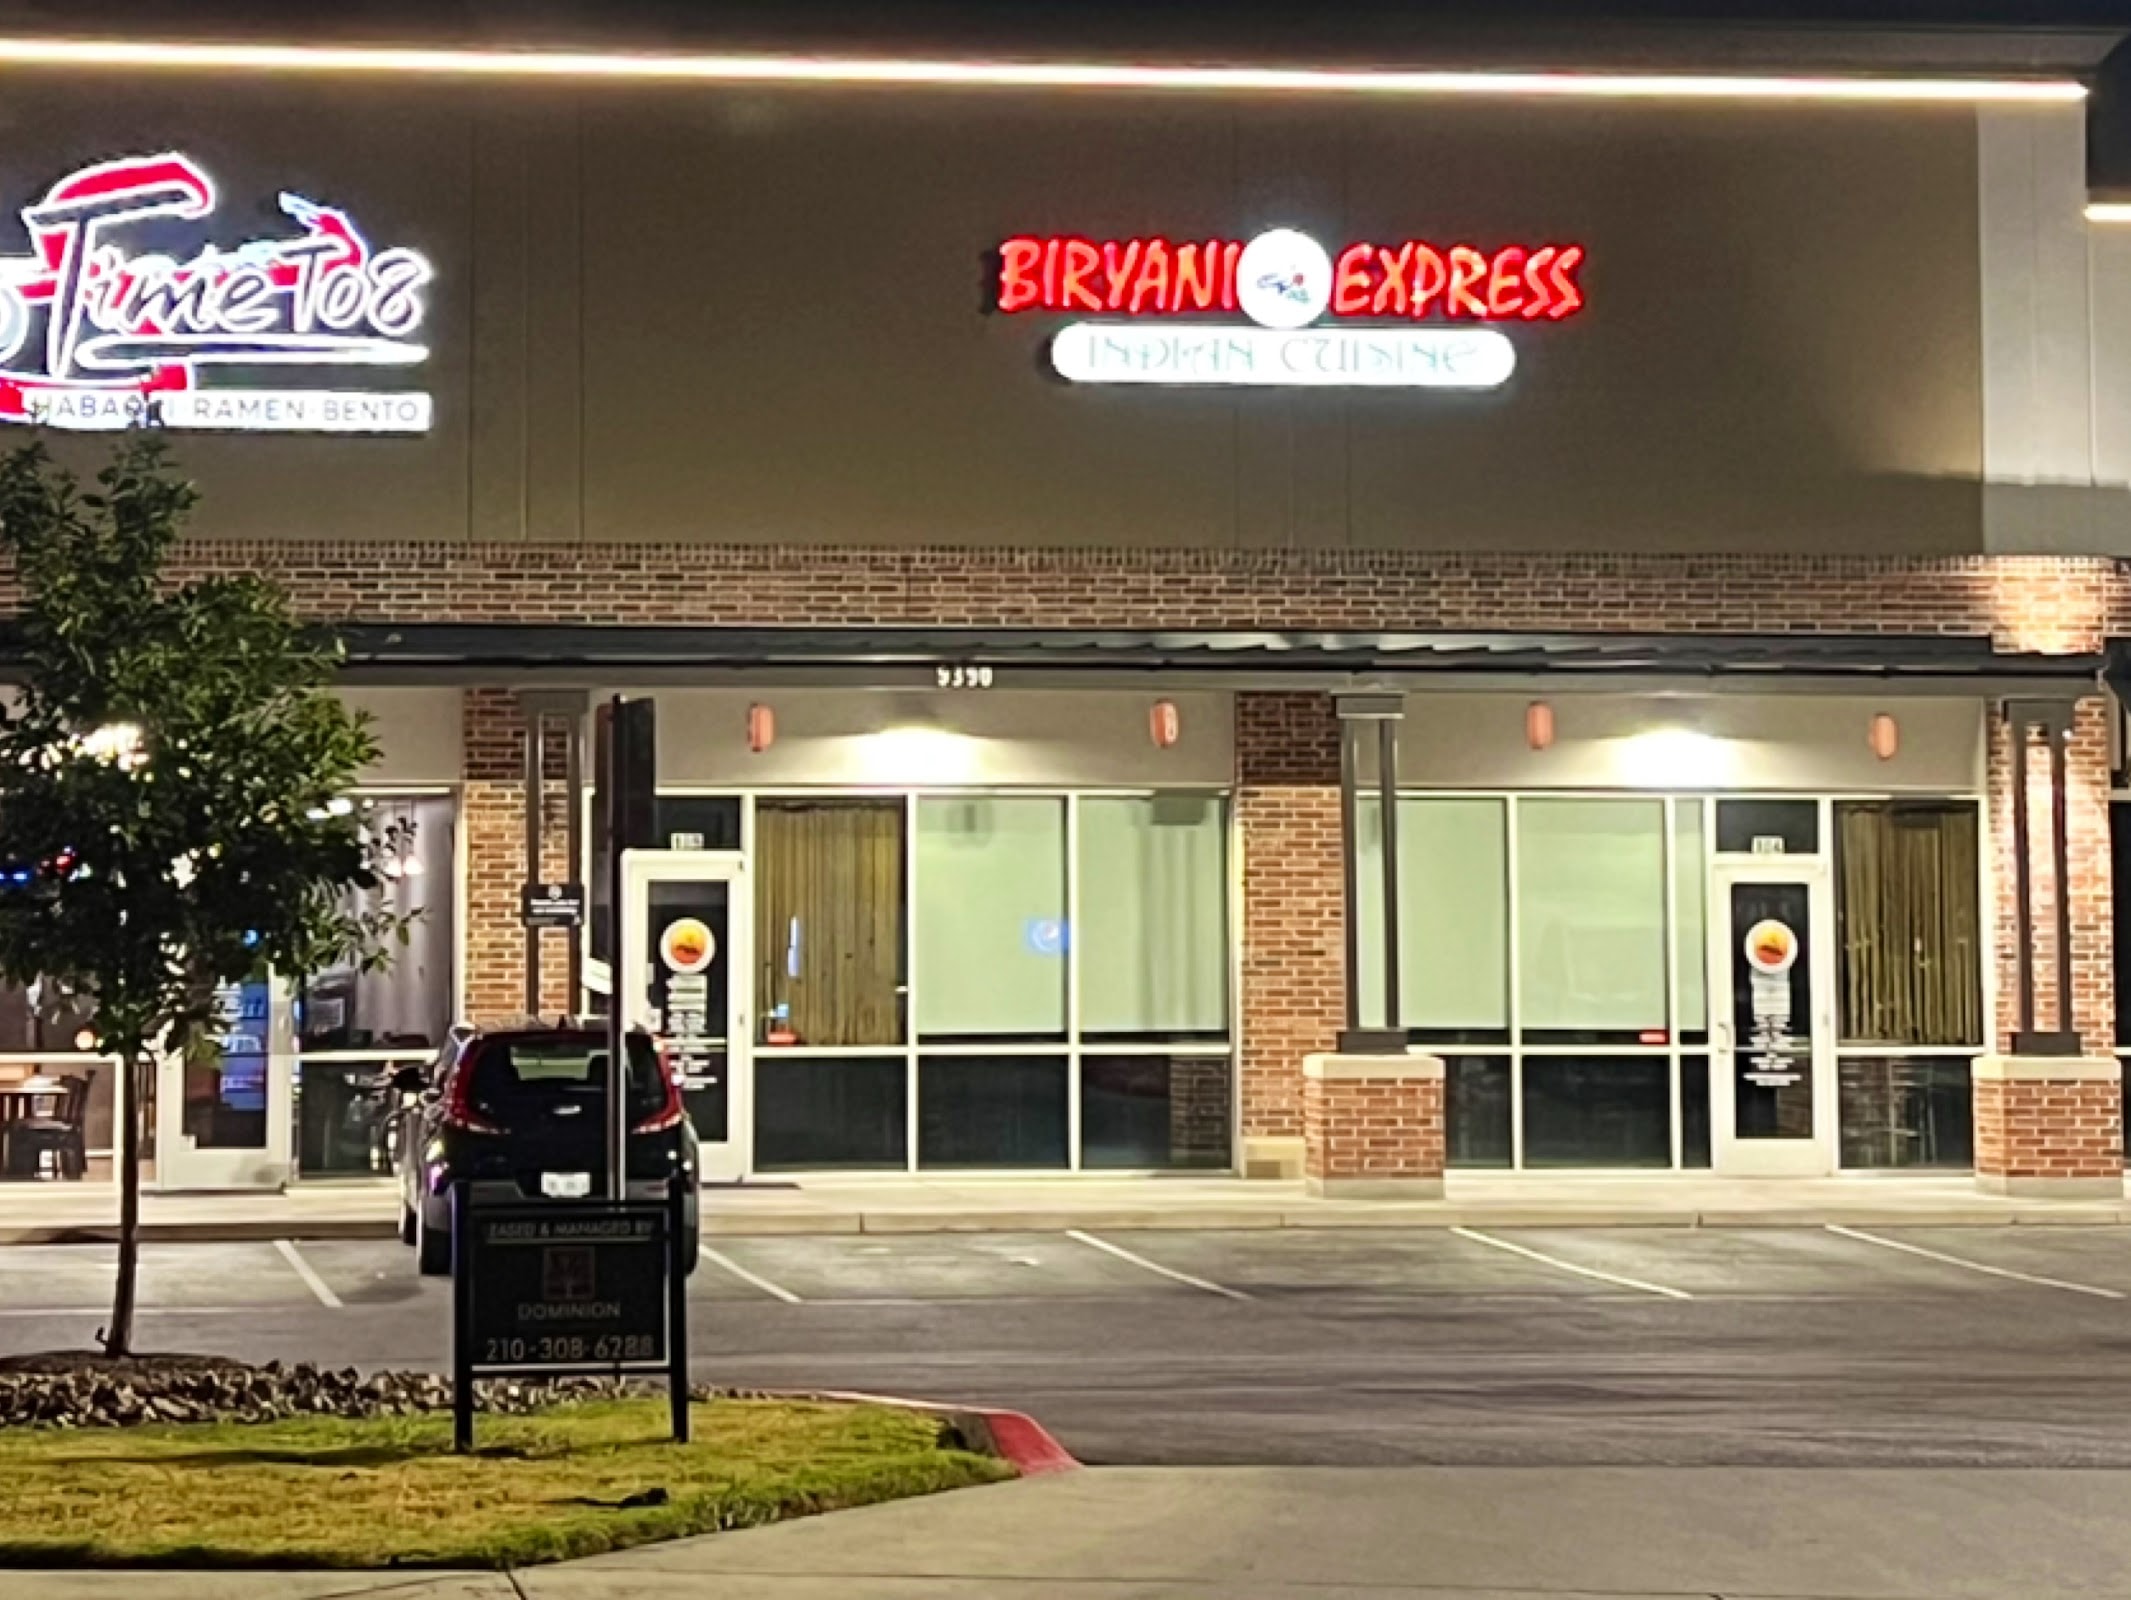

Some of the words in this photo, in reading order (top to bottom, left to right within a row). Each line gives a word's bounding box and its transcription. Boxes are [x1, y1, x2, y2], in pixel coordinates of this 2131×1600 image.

[999, 237, 1240, 313] BIRYANI
[1333, 242, 1585, 320] EXPRESS
[1087, 334, 1254, 372] INDIAN
[31, 394, 174, 419] HABAI
[193, 396, 304, 421] RAMEN
[324, 399, 418, 422] BENTO
[518, 1302, 621, 1320] DOMINION
